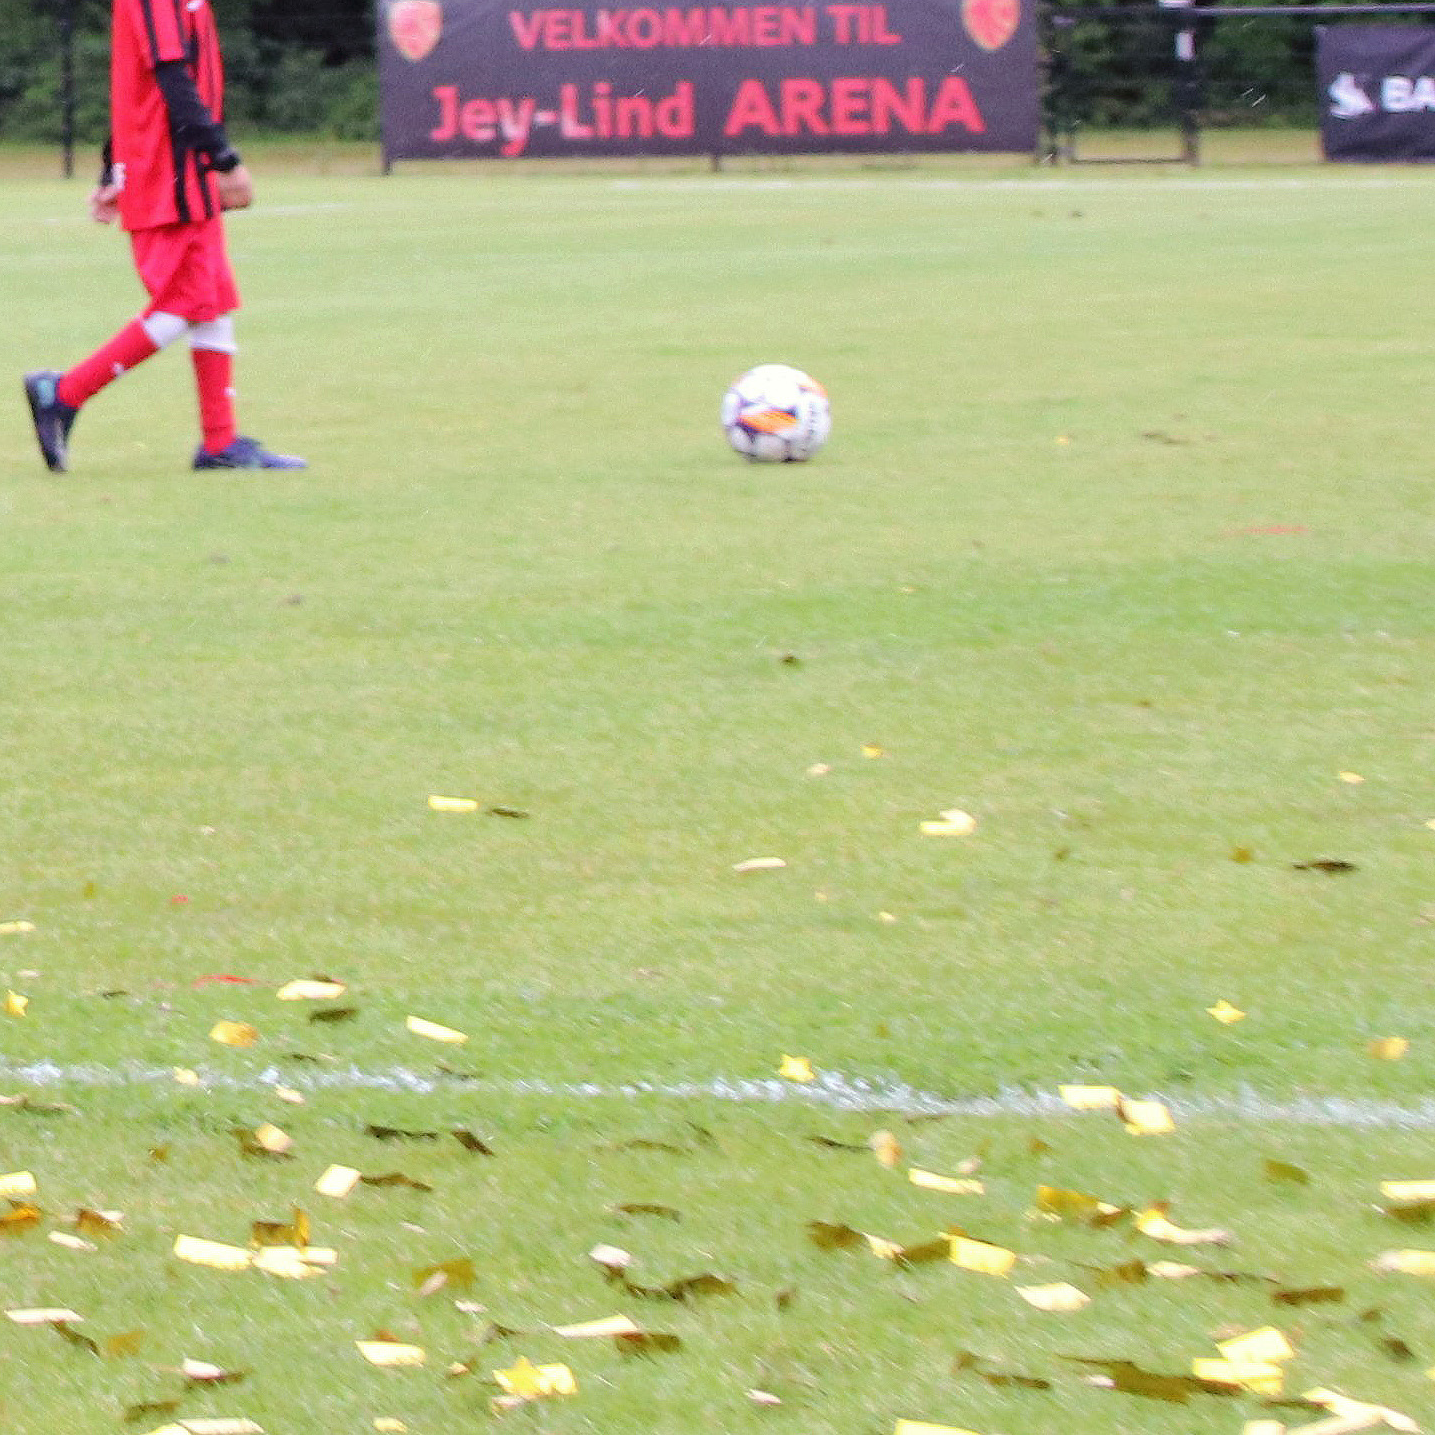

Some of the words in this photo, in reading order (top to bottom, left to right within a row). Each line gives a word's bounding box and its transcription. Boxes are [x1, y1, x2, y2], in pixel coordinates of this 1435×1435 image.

[509, 6, 816, 50] VELKOMMEN
[827, 4, 901, 45] TIL
[431, 81, 694, 158] Jey-Lind
[724, 76, 984, 136] ARENA
